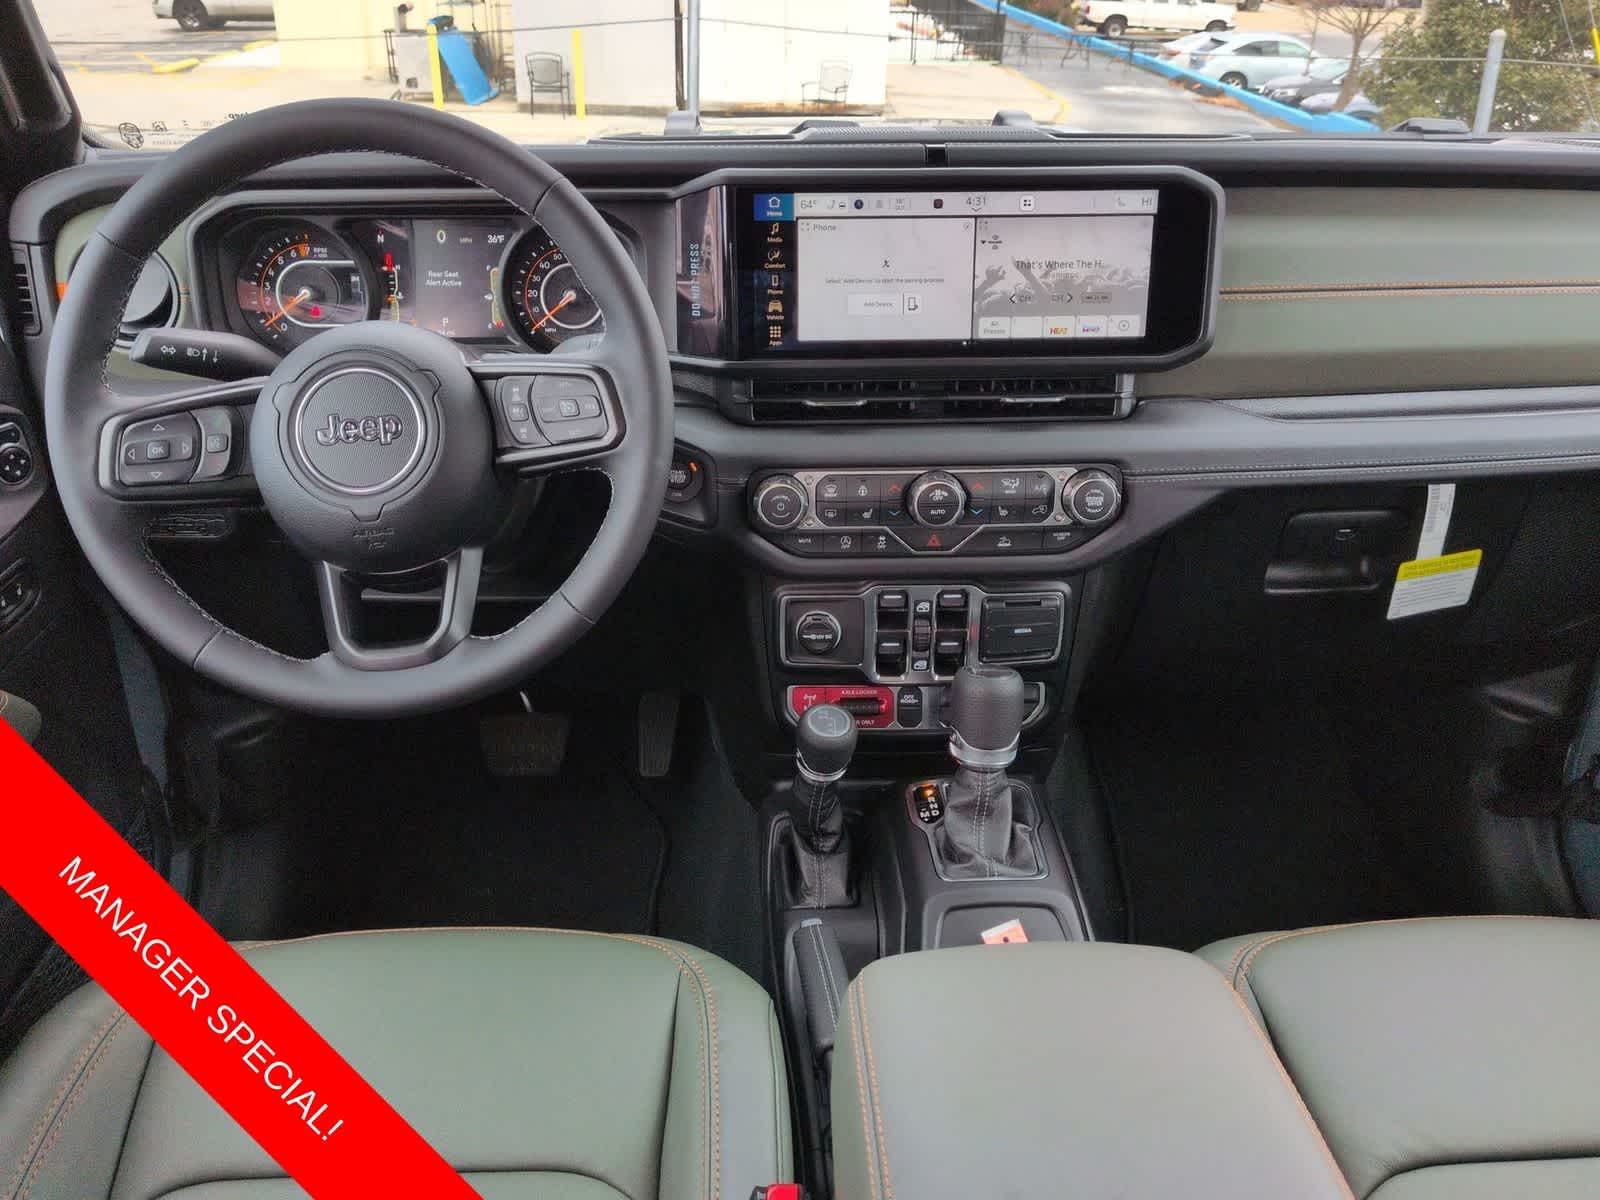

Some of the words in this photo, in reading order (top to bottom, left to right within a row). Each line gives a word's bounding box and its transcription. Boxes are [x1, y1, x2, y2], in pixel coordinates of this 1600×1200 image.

[436, 229, 446, 244] 0
[290, 249, 297, 257] 6
[277, 257, 284, 265] 5
[690, 243, 700, 276] PRESS
[540, 261, 550, 269] 40
[1044, 259, 1072, 269] Where
[268, 269, 275, 277] 4
[428, 270, 443, 278] Rear
[444, 270, 459, 278] Seat
[264, 282, 271, 290] 3
[442, 279, 462, 287] Active
[528, 289, 538, 297] 20
[265, 297, 272, 305] 2
[280, 323, 288, 331] 0
[316, 413, 404, 446] Jeep
